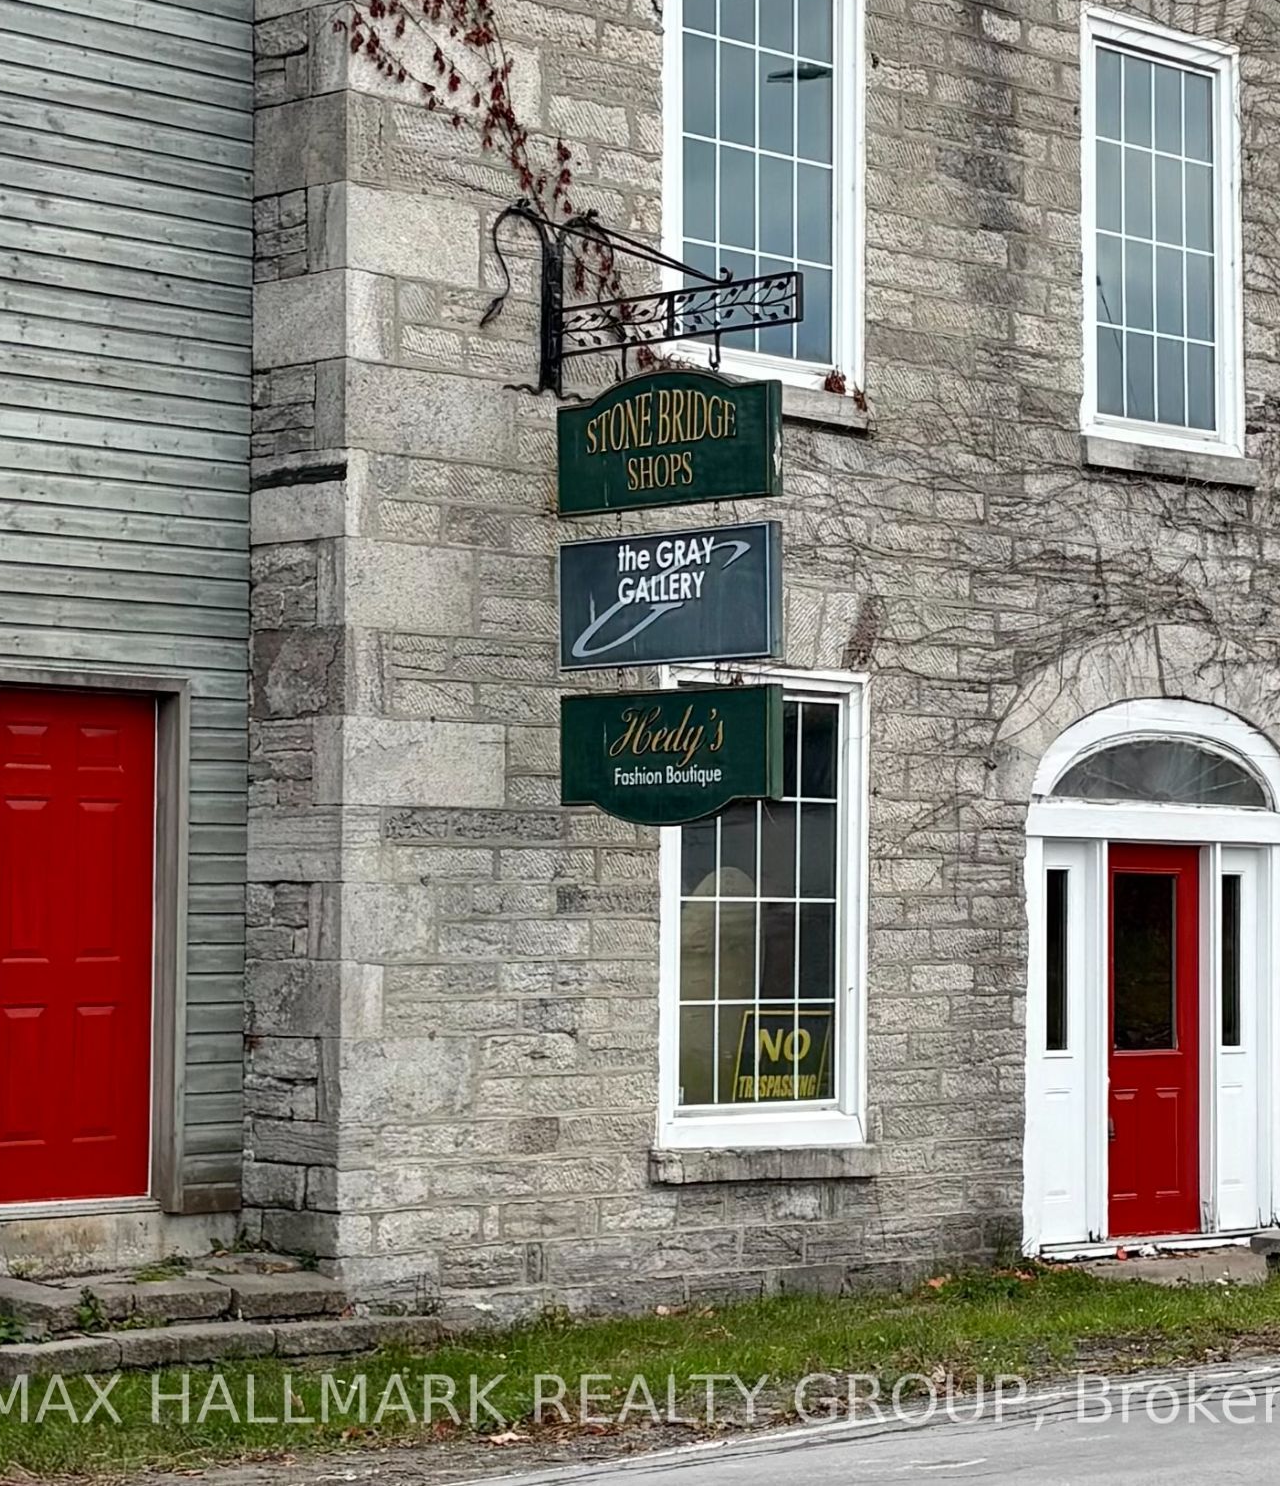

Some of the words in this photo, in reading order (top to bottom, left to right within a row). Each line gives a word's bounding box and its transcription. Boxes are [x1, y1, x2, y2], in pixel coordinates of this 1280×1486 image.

[586, 393, 653, 454] STONE
[657, 389, 736, 445] BRIDGE
[627, 451, 693, 491] SHOPS
[618, 544, 650, 572] the
[656, 536, 715, 568] GRAY
[618, 571, 705, 605] GALLERY
[609, 704, 724, 768] Hedy's
[614, 766, 662, 786] Fashion
[665, 764, 722, 787] Boutique
[758, 1028, 811, 1062] NO
[739, 1074, 817, 1098] TRSPASSNG
